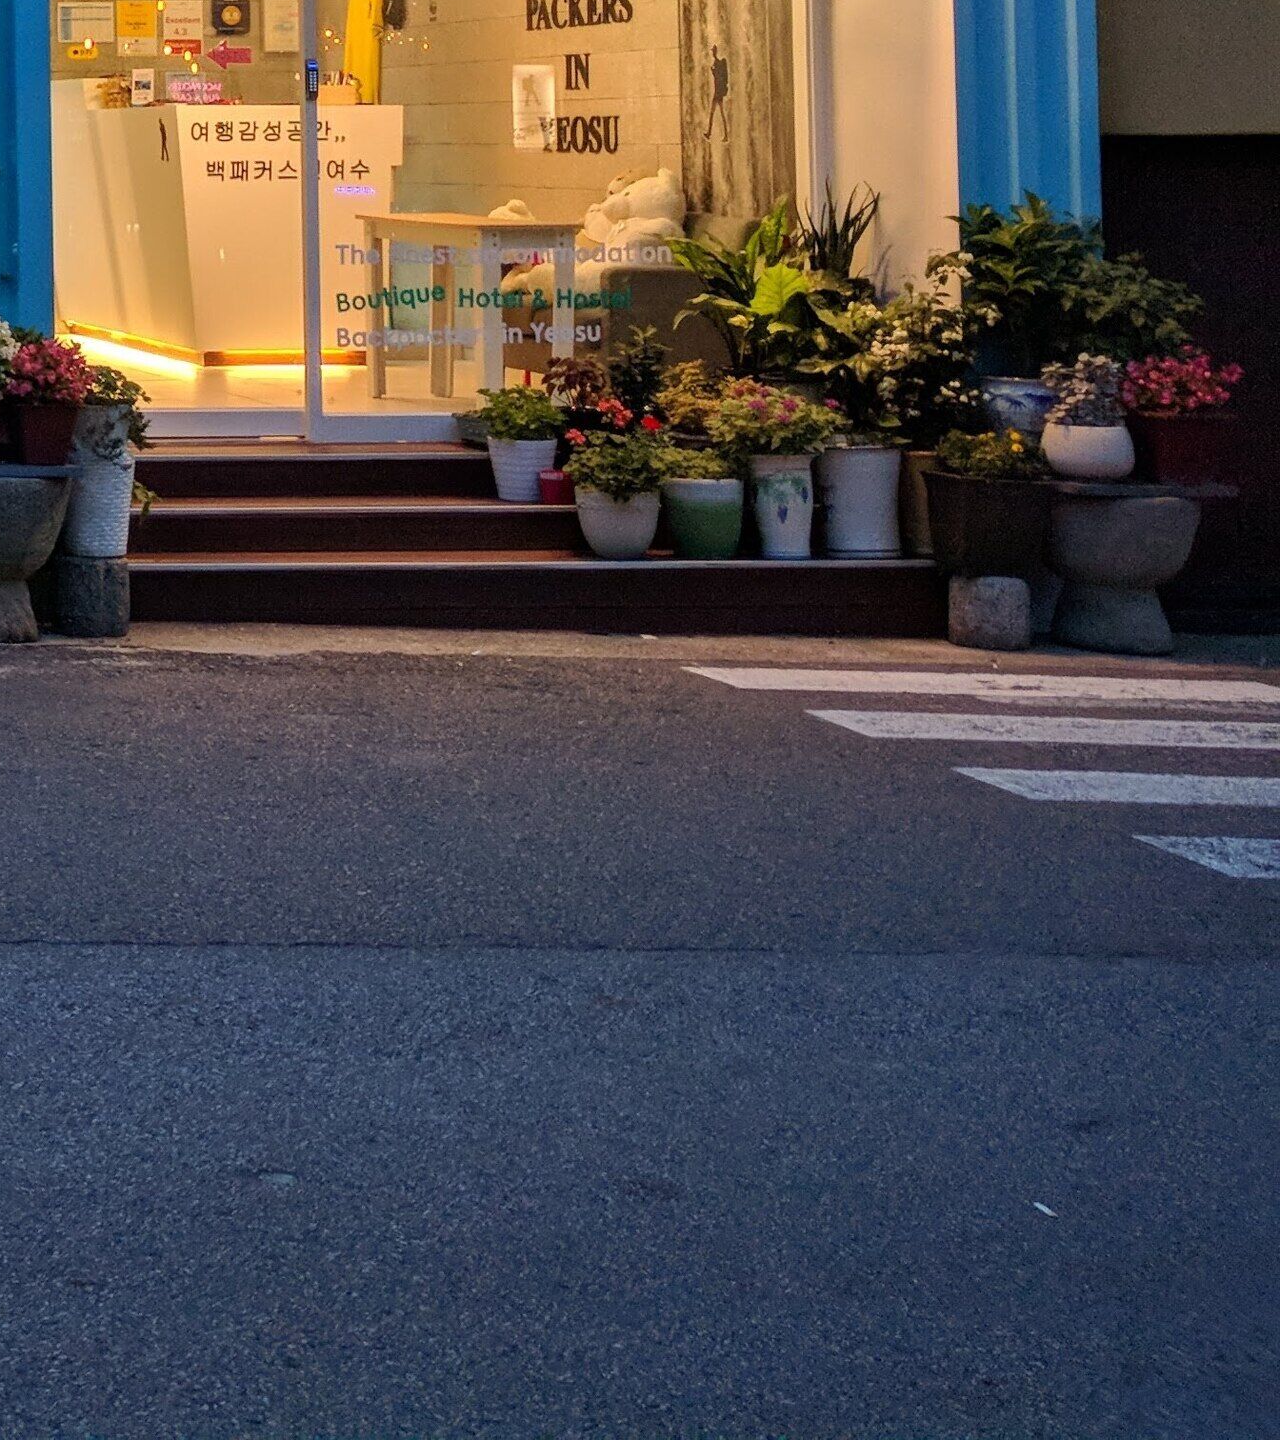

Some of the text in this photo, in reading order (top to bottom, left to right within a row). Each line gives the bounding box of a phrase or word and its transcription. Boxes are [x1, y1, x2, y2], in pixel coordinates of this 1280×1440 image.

[564, 53, 590, 90] IN
[206, 159, 370, 182] 백패커스여수
[336, 283, 633, 313] Boutique Hotel & Hostel
[502, 322, 524, 344] in
